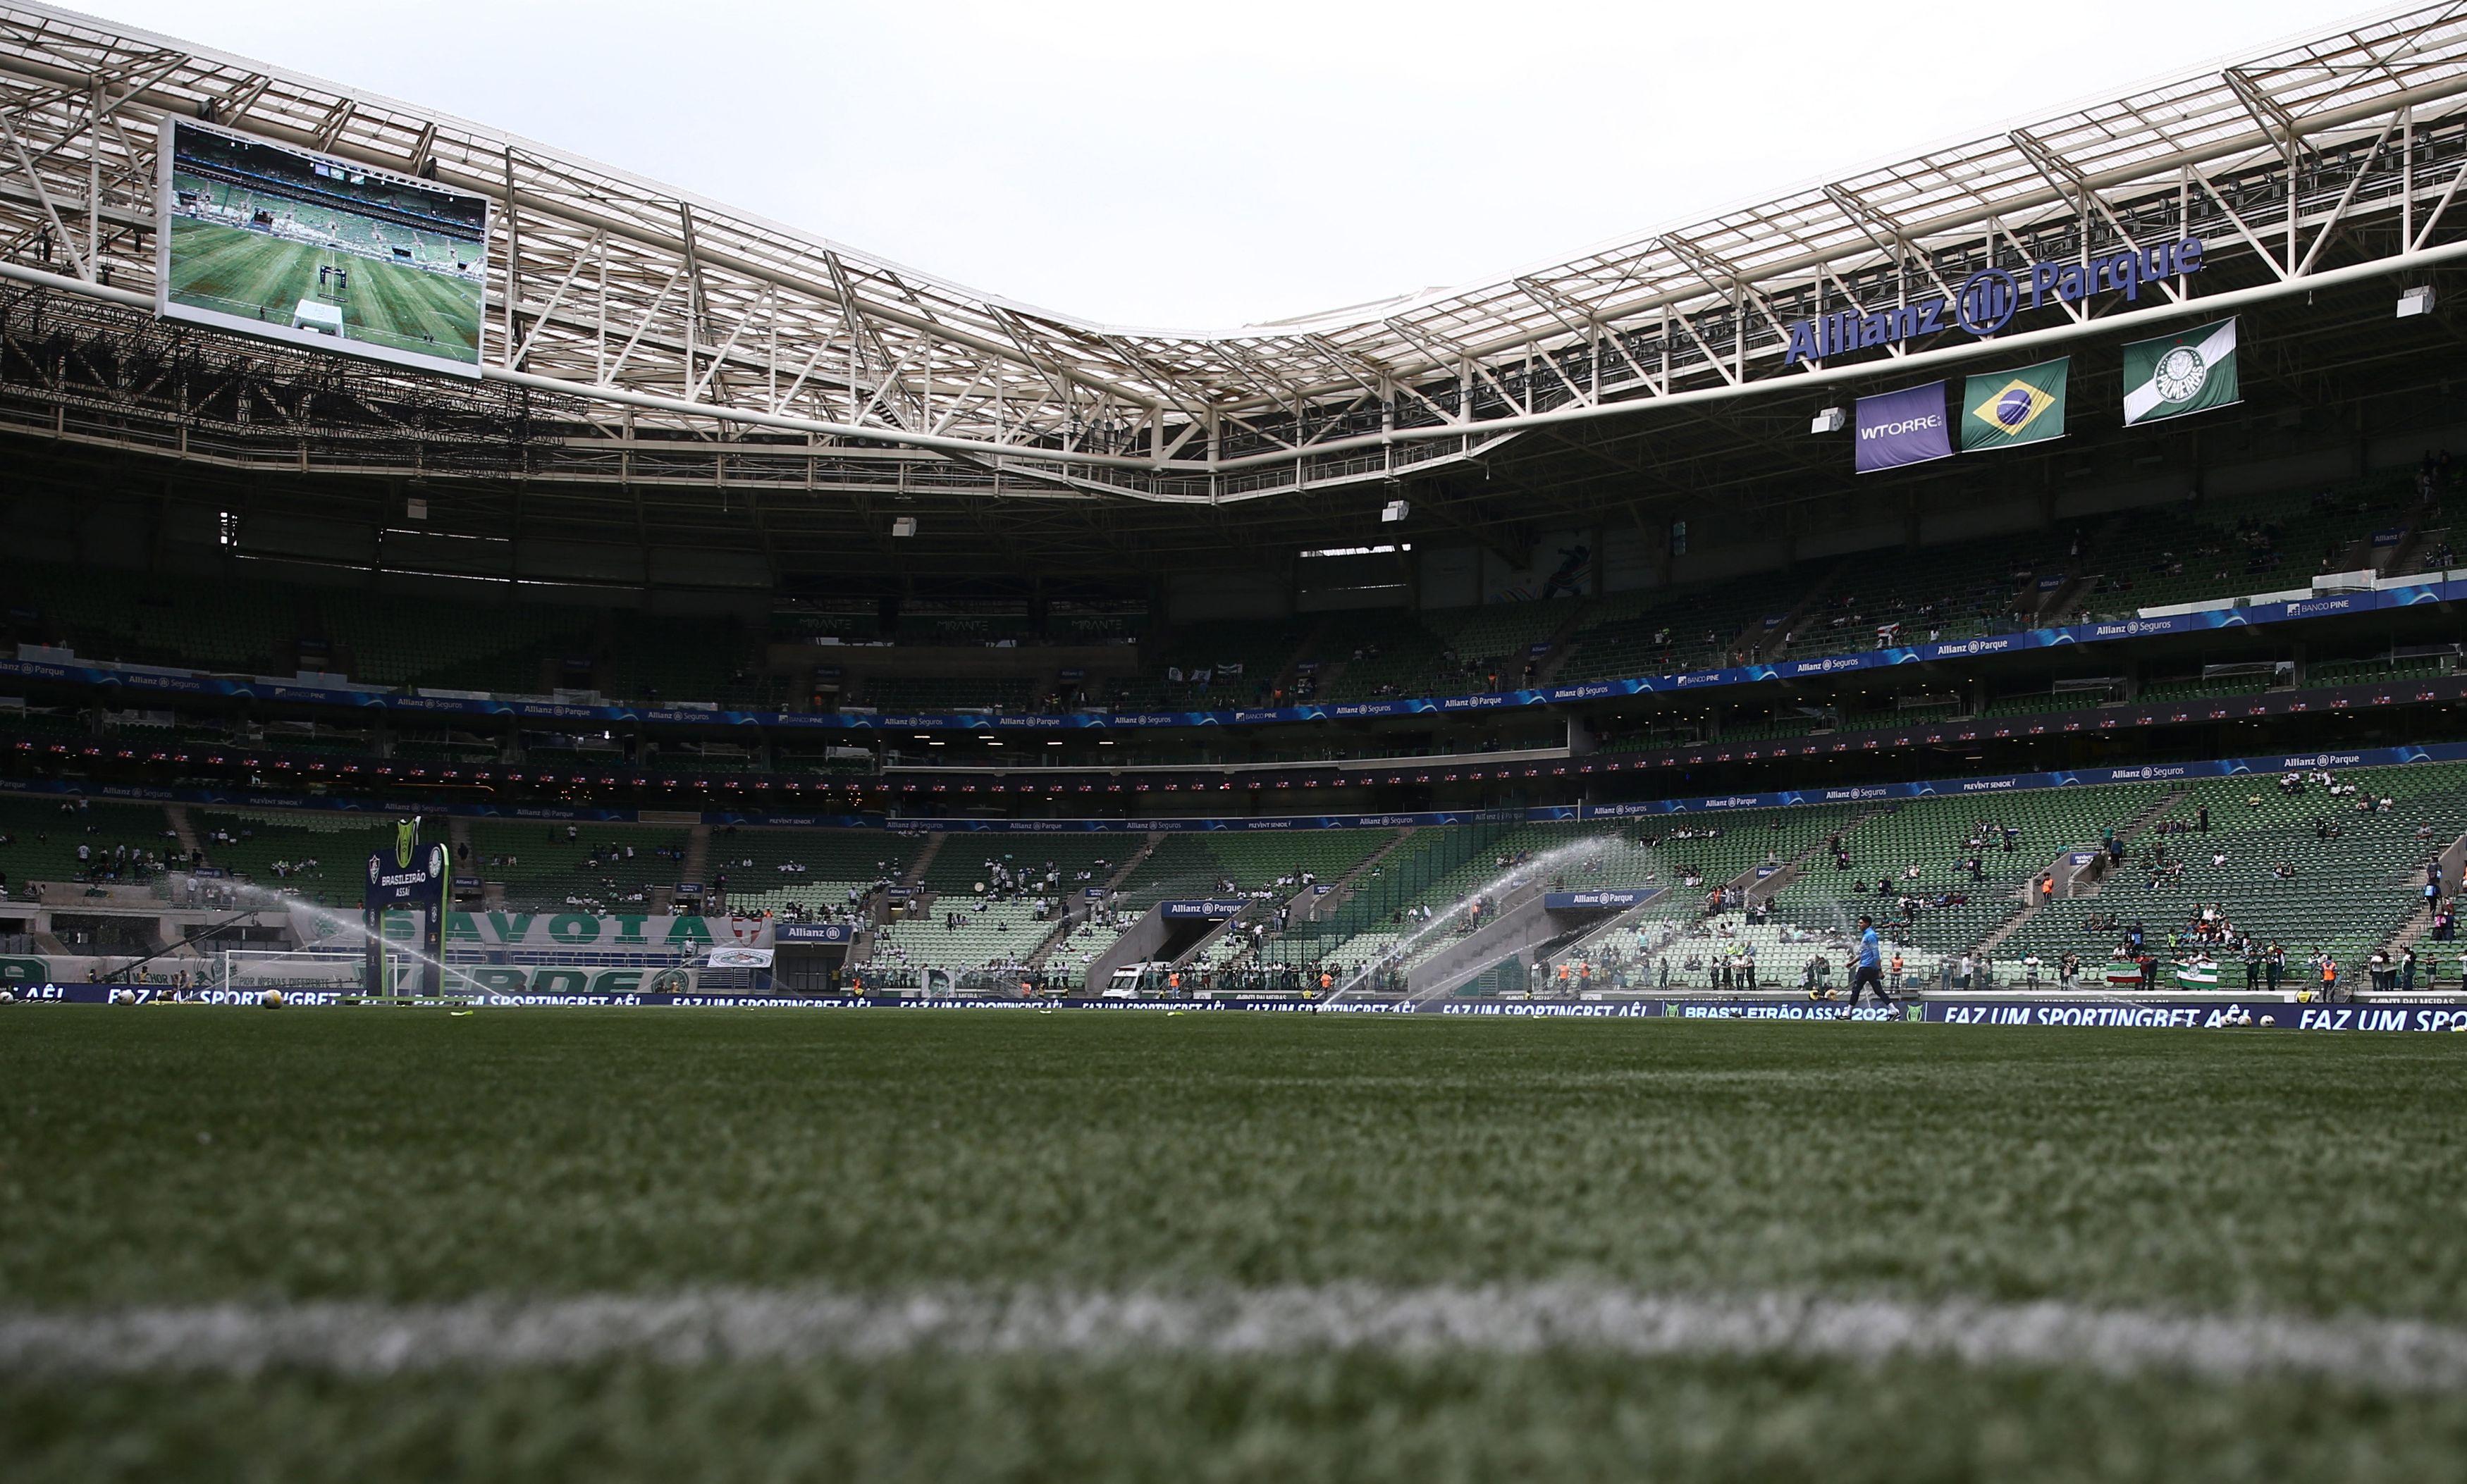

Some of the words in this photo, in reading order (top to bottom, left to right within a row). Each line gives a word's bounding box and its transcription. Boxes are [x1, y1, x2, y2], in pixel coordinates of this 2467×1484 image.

[1785, 297, 1945, 366] Allianz
[2031, 237, 2203, 307] Parque
[1862, 414, 1937, 440] WTORRE
[2301, 602, 2329, 612] BANCO
[2330, 600, 2349, 609] PINE
[799, 619, 851, 630] MIRANTE
[937, 620, 988, 631] MIRANTE
[1071, 619, 1123, 630] MIRANTE
[2096, 624, 2126, 635] Allianz
[2139, 620, 2171, 632] Seguros
[1938, 643, 1967, 655] Allianz
[1980, 639, 2007, 651] Parque
[1797, 662, 1821, 672] Allianz
[1833, 658, 1858, 669] Seguros
[35, 666, 65, 676] Parque
[129, 674, 157, 686] Allianz
[171, 679, 200, 690] Seguros
[1706, 674, 1719, 682] PINE
[287, 691, 309, 699] BANCO
[1555, 688, 1576, 698] Allianz
[1585, 686, 1608, 695] Seguros
[398, 698, 424, 707] Allianz
[436, 700, 462, 709] Seguros
[1445, 698, 1469, 707] Allianz
[1479, 696, 1502, 707] Parque
[524, 705, 552, 715] Allianz
[565, 708, 590, 717] Parque
[1336, 706, 1360, 715] Allianz
[1368, 705, 1391, 715] Seguros
[684, 713, 709, 722] Seguros
[918, 717, 943, 726] Seguros
[1036, 717, 1059, 726] Parque
[1148, 716, 1171, 724] Seguros
[2284, 756, 2315, 767] Allianz
[2330, 754, 2360, 765] Parque
[2112, 768, 2140, 779] Allianz
[2153, 766, 2184, 777] Seguros
[0, 780, 26, 790] Parque
[1964, 781, 1989, 790] PREVENT
[1991, 780, 2011, 789] SENIOR
[103, 787, 130, 796] Allianz
[143, 789, 173, 798] Seguros
[1826, 790, 1850, 799] Allianz
[1860, 788, 1887, 798] Seguros
[1737, 797, 1757, 807] Parque
[422, 804, 448, 813] Seguros
[1625, 805, 1647, 815] Seguros
[552, 810, 574, 819] Parque
[918, 822, 943, 830] Seguros
[1158, 822, 1181, 830] Seguros
[1390, 816, 1413, 825] Seguros
[1042, 822, 1062, 831] Parque
[382, 870, 426, 886] BRASILEIRÃO
[1573, 894, 1599, 903] Allianz
[1610, 894, 1633, 904] Parque
[1172, 903, 1200, 913] Allianz
[1214, 903, 1241, 915] Parque
[789, 927, 825, 937] Allianz
[108, 988, 150, 1005] FZ
[1685, 1003, 1803, 1020] BRASILEIRÃO
[1945, 1007, 1986, 1024] FAZ
[1991, 1008, 2031, 1025] UM
[2037, 1008, 2200, 1027] SPORTINGBET
[2299, 1010, 2352, 1031] FAZ
[2357, 1010, 2407, 1031] UM
